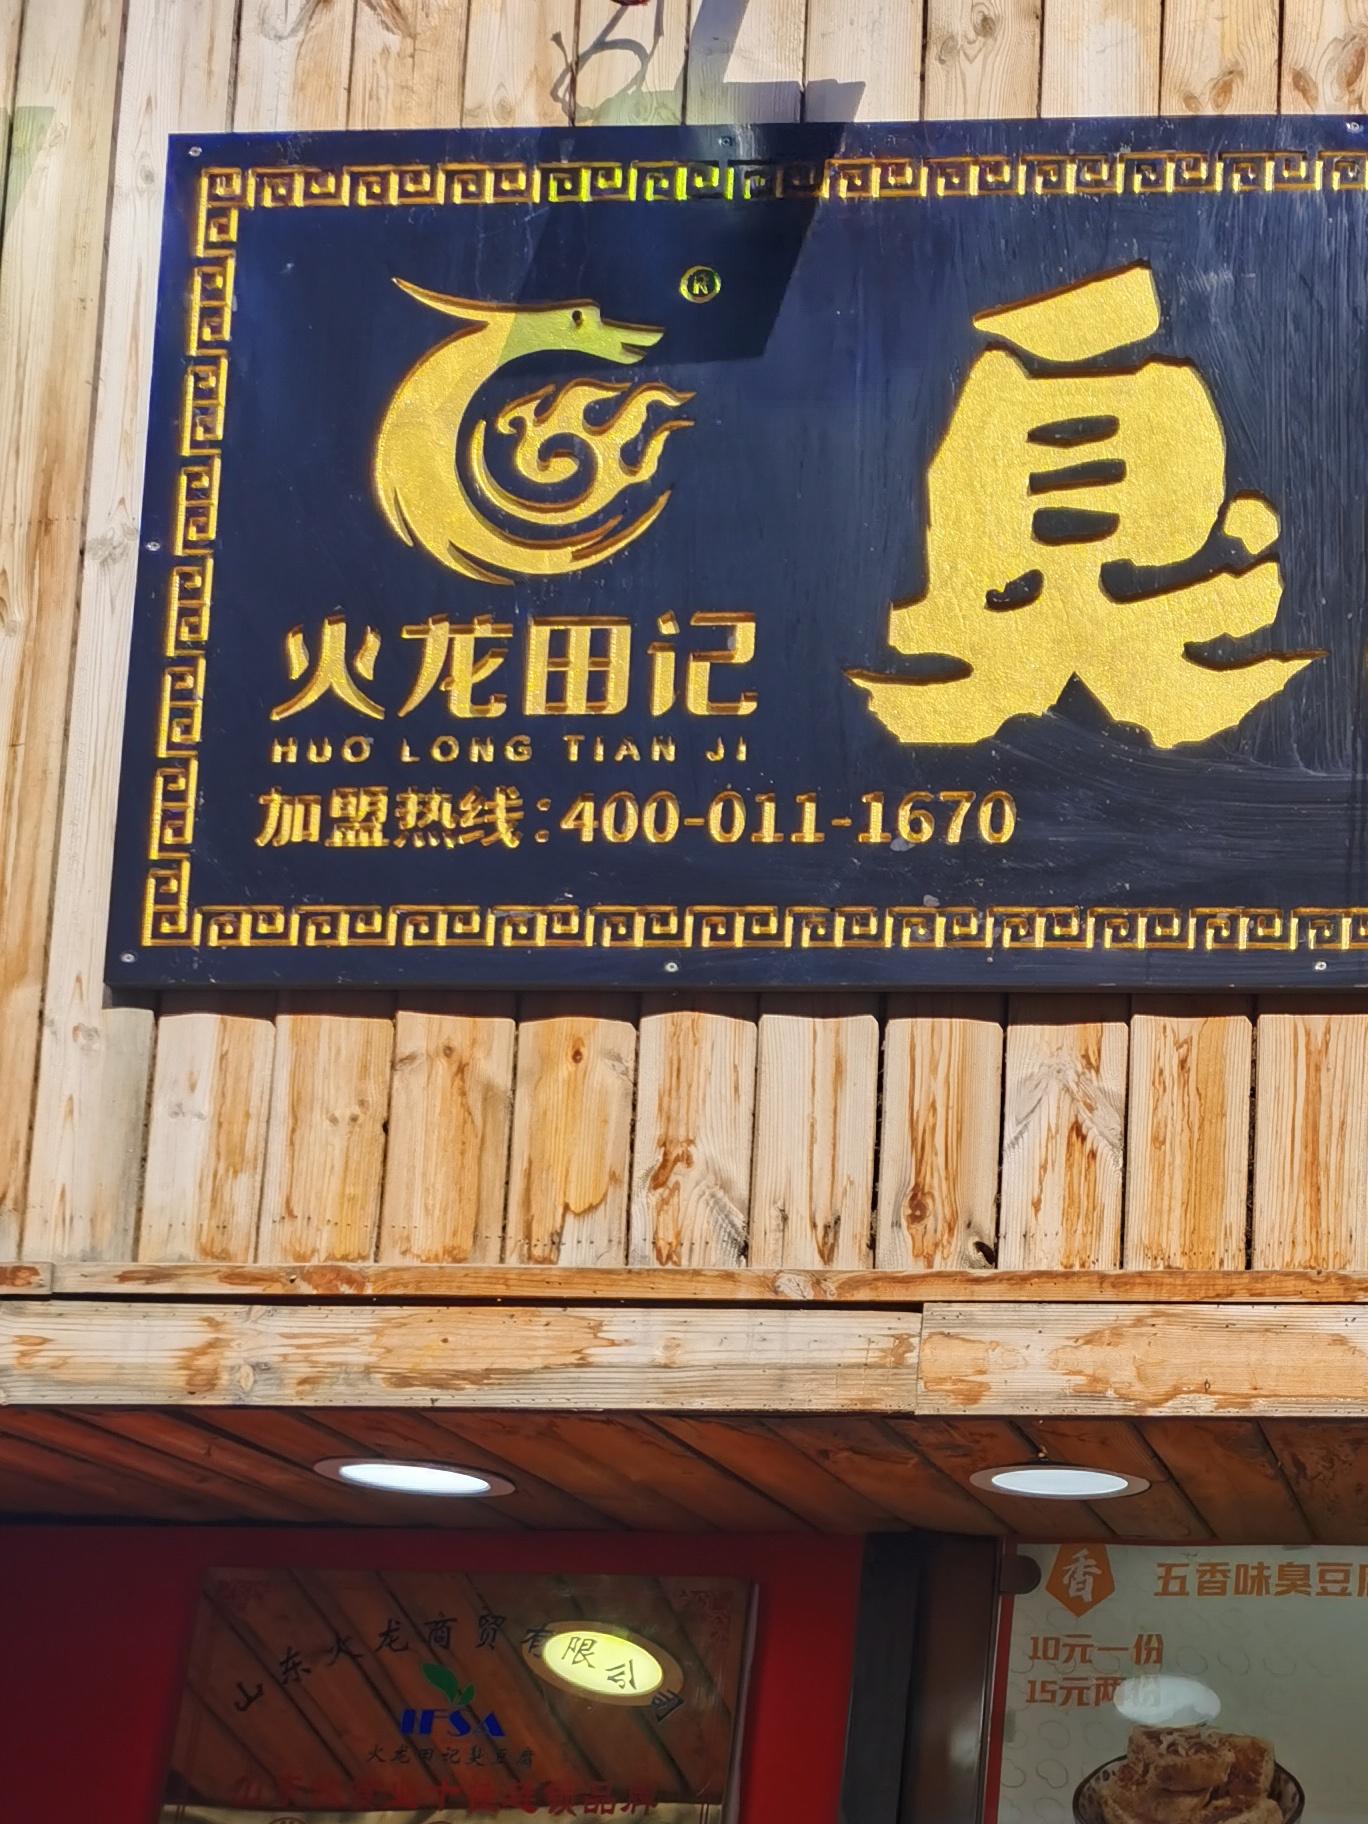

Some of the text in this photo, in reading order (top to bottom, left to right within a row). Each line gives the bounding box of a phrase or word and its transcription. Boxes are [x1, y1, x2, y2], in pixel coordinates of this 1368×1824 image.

[267, 611, 759, 722] 火龙田记
[272, 735, 749, 763] HUO LONG TIAN JI
[1062, 1553, 1101, 1603] 香
[1028, 1633, 1164, 1666] 10元一份
[400, 1709, 506, 1738] IFSA
